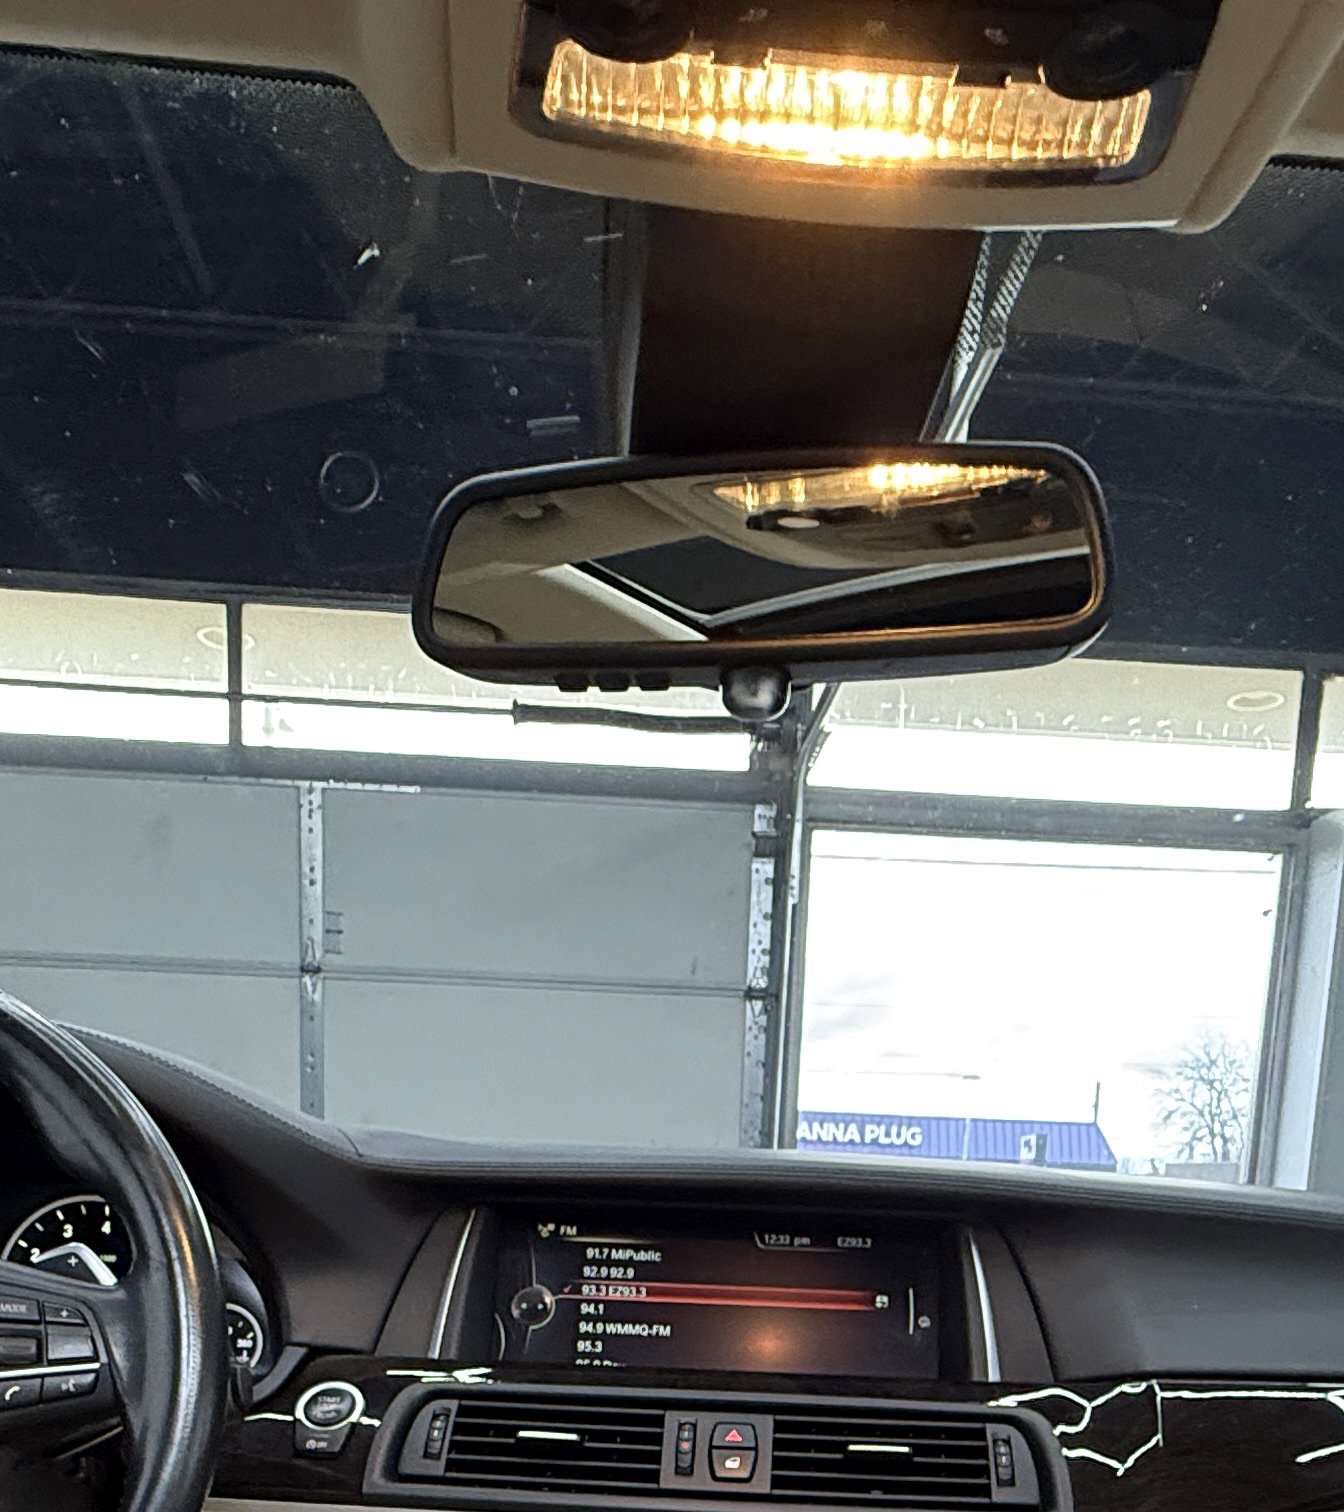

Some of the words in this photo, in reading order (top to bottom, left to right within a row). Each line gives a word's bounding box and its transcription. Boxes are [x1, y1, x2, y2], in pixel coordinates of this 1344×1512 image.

[796, 1120, 862, 1144] ANNA
[864, 1124, 923, 1146] PLUG
[63, 1224, 73, 1238] 3
[101, 1221, 111, 1235] 4
[559, 1225, 577, 1236] FM
[794, 1237, 811, 1247] pm
[586, 1247, 609, 1260] 91.7
[583, 1266, 608, 1278] 92.9
[610, 1267, 635, 1279] 92.9
[582, 1285, 607, 1296] 93.3
[580, 1303, 605, 1315] 94.1
[579, 1321, 604, 1334] 94.9
[577, 1340, 603, 1353] 95.3
